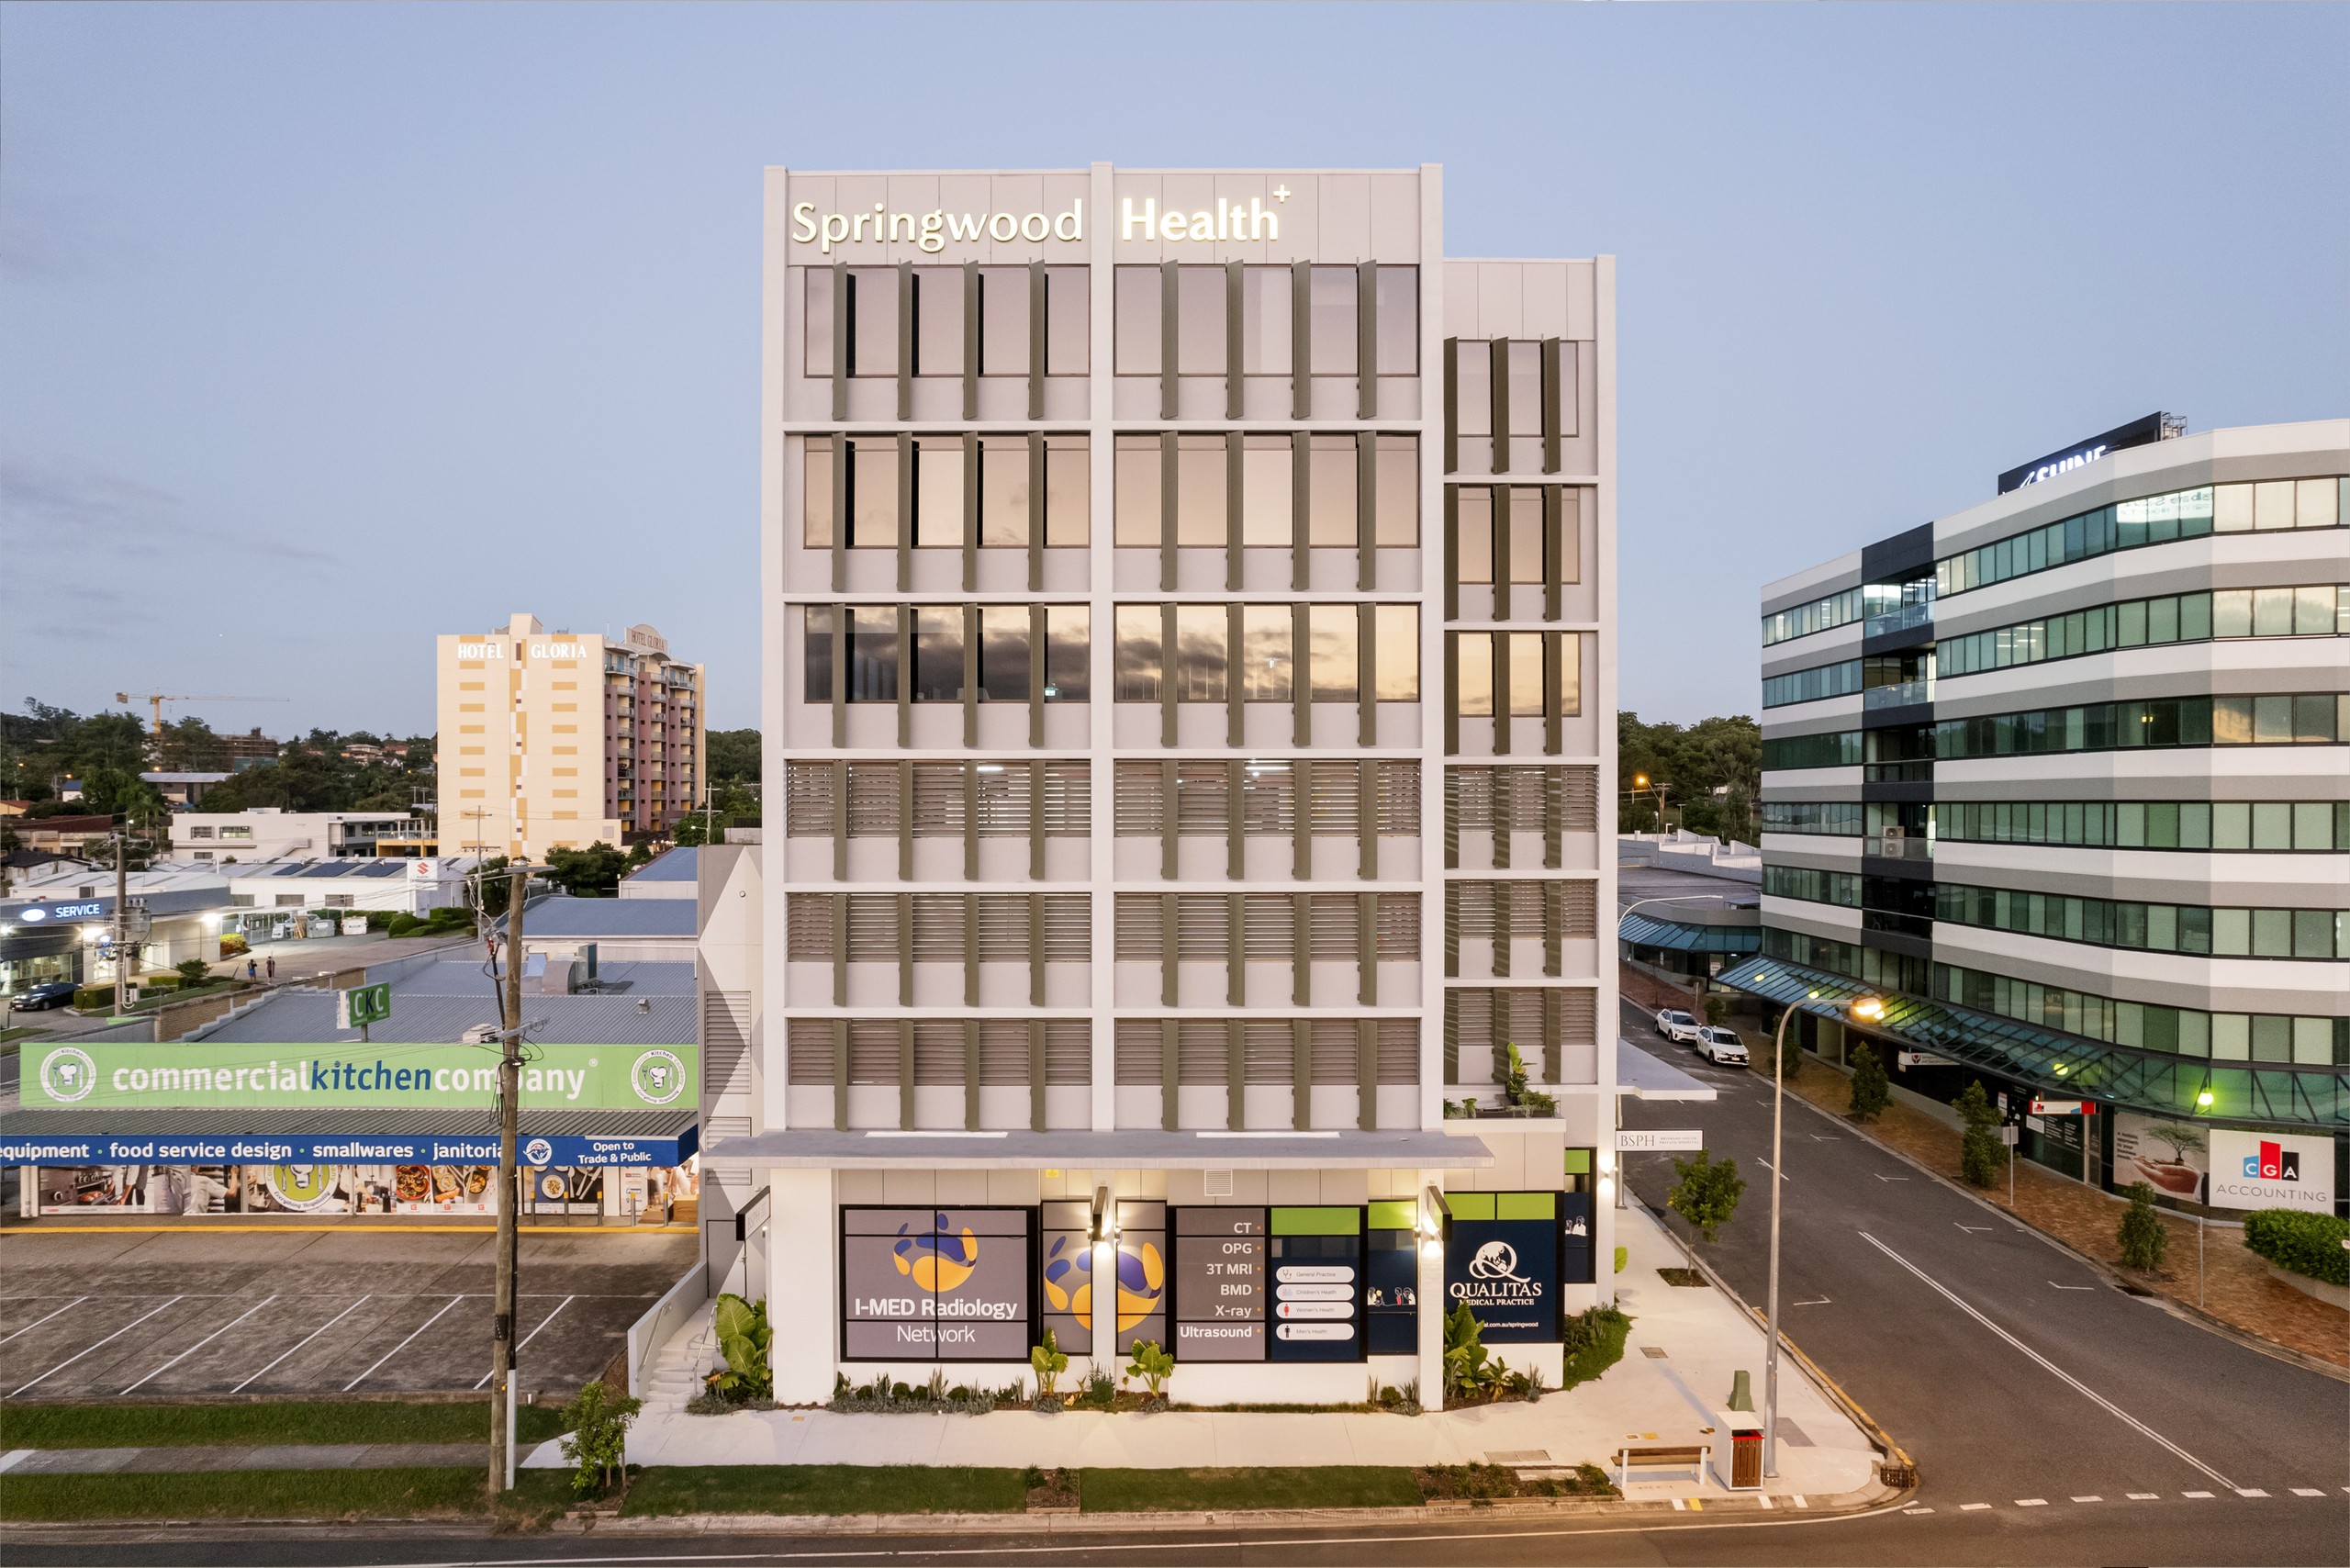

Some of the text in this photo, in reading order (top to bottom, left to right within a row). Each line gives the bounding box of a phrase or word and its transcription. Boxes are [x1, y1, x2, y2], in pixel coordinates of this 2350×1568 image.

[791, 197, 1082, 254] Springwood
[631, 630, 665, 652] HOTEL GLORIA
[457, 644, 588, 659] HOTEL GLORIA
[55, 903, 100, 918] SERVICE
[354, 987, 384, 1018] CKC
[650, 1050, 674, 1059] Kitchen
[112, 1059, 586, 1100] commercialkitchencomany
[592, 1141, 634, 1153] Open to
[1620, 1135, 1655, 1147] BSPH
[0, 1142, 89, 1161] quipment
[109, 1142, 154, 1158] food
[159, 1142, 226, 1158] service
[230, 1142, 292, 1160] design
[312, 1141, 414, 1158] smallwares
[577, 1151, 652, 1164] Trade & Public
[2245, 1163, 2297, 1179] CGA
[2216, 1183, 2327, 1203] ACCOUNTING
[1233, 1222, 1252, 1234] CT
[1222, 1242, 1252, 1254] OPG
[1206, 1263, 1252, 1275] 3T MRI
[1220, 1284, 1252, 1295] BMD
[1449, 1282, 1542, 1299] QUALITAS
[855, 1298, 1018, 1320] I-MED Radiology
[1496, 1298, 1535, 1306] PRACTICE
[1214, 1305, 1252, 1318] X-ray
[1180, 1326, 1252, 1338] Ultrasound
[1477, 1321, 1539, 1329] al.com.au/springwood
[897, 1325, 976, 1342] Network
